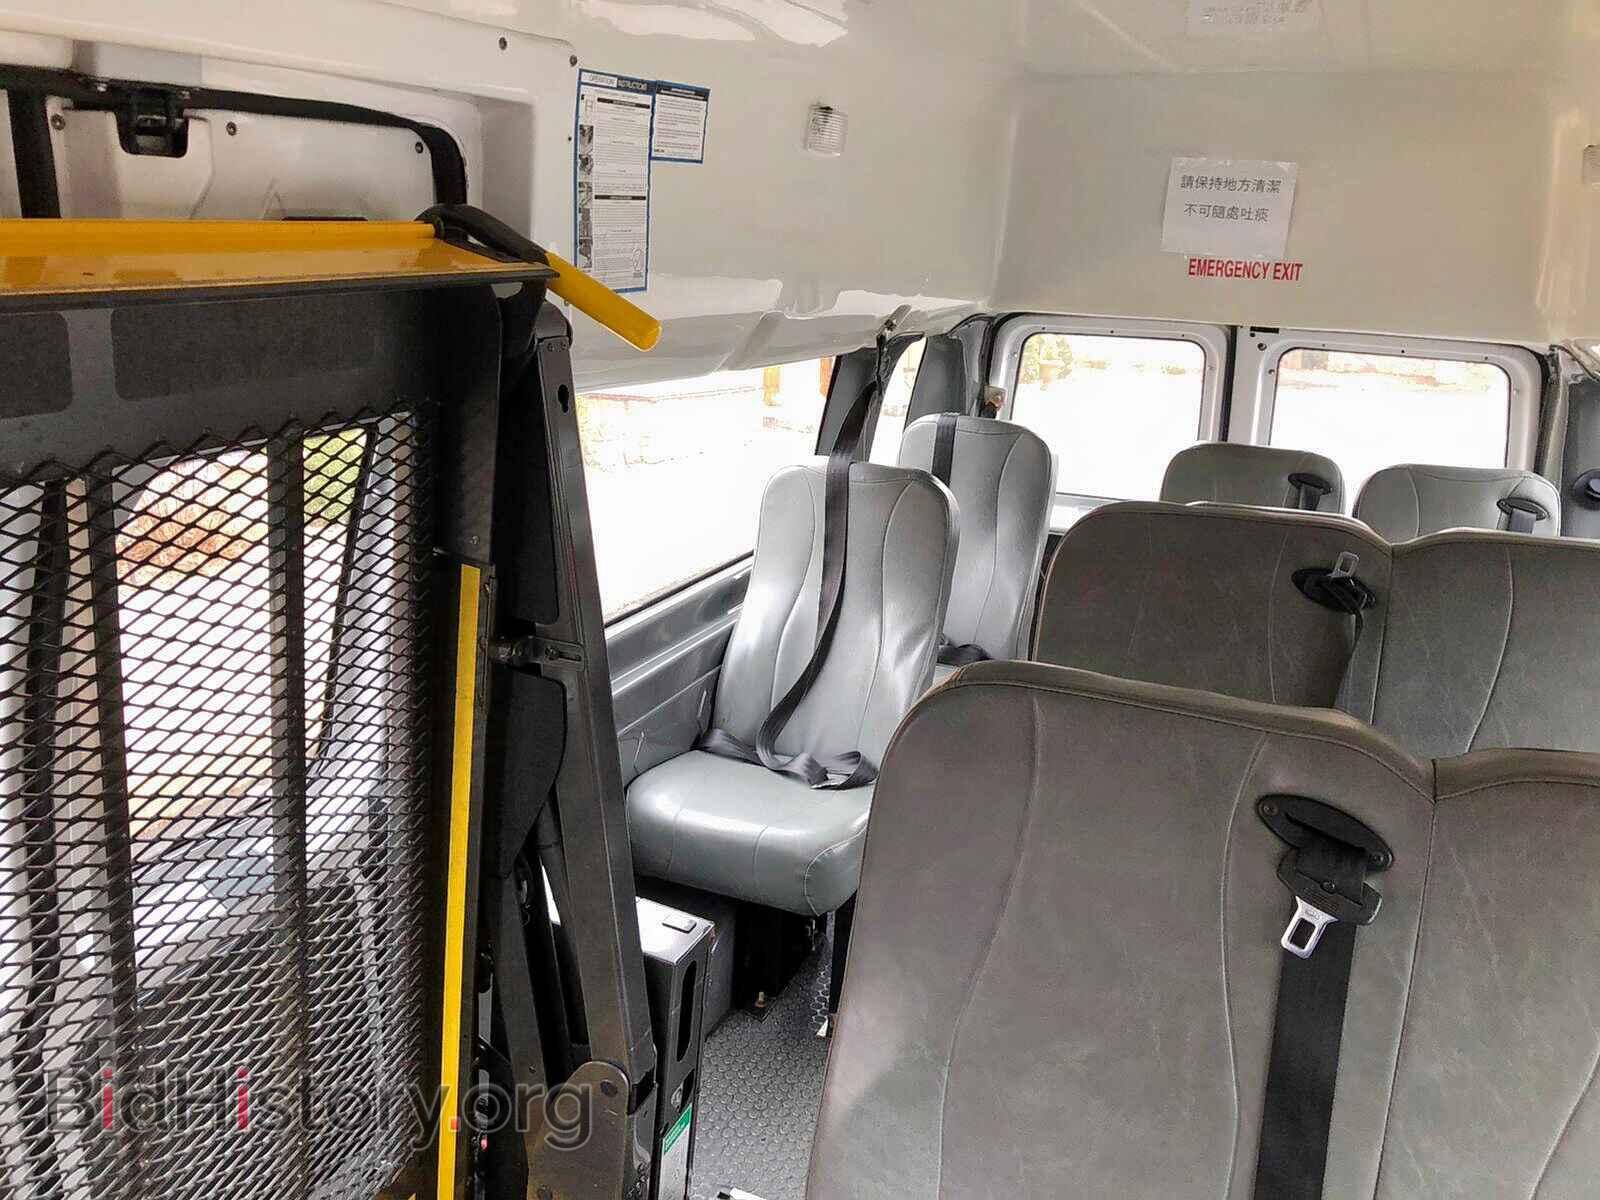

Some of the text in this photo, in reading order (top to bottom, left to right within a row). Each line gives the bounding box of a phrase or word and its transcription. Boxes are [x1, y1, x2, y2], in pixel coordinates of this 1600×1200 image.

[1180, 175, 1282, 194] 請保持地方清潔
[1188, 258, 1303, 281] EMERGENCY EXIT
